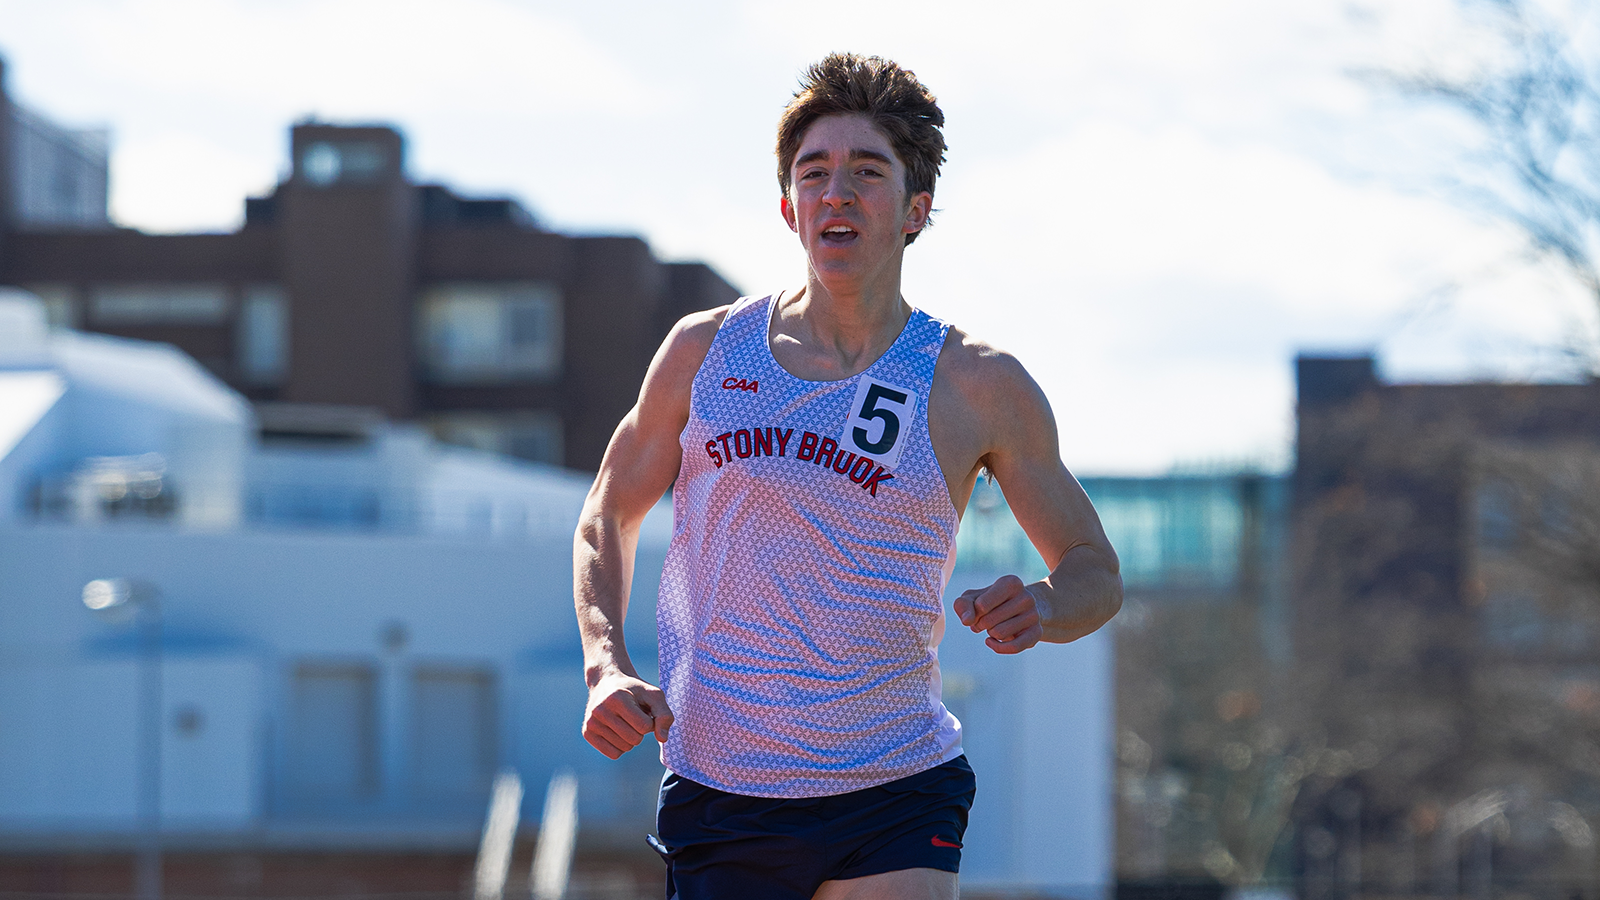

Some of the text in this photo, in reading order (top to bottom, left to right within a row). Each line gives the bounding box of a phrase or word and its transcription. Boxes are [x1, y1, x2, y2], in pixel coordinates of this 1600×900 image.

[722, 377, 759, 393] CAA
[852, 383, 908, 455] 5
[705, 427, 794, 468] STONY
